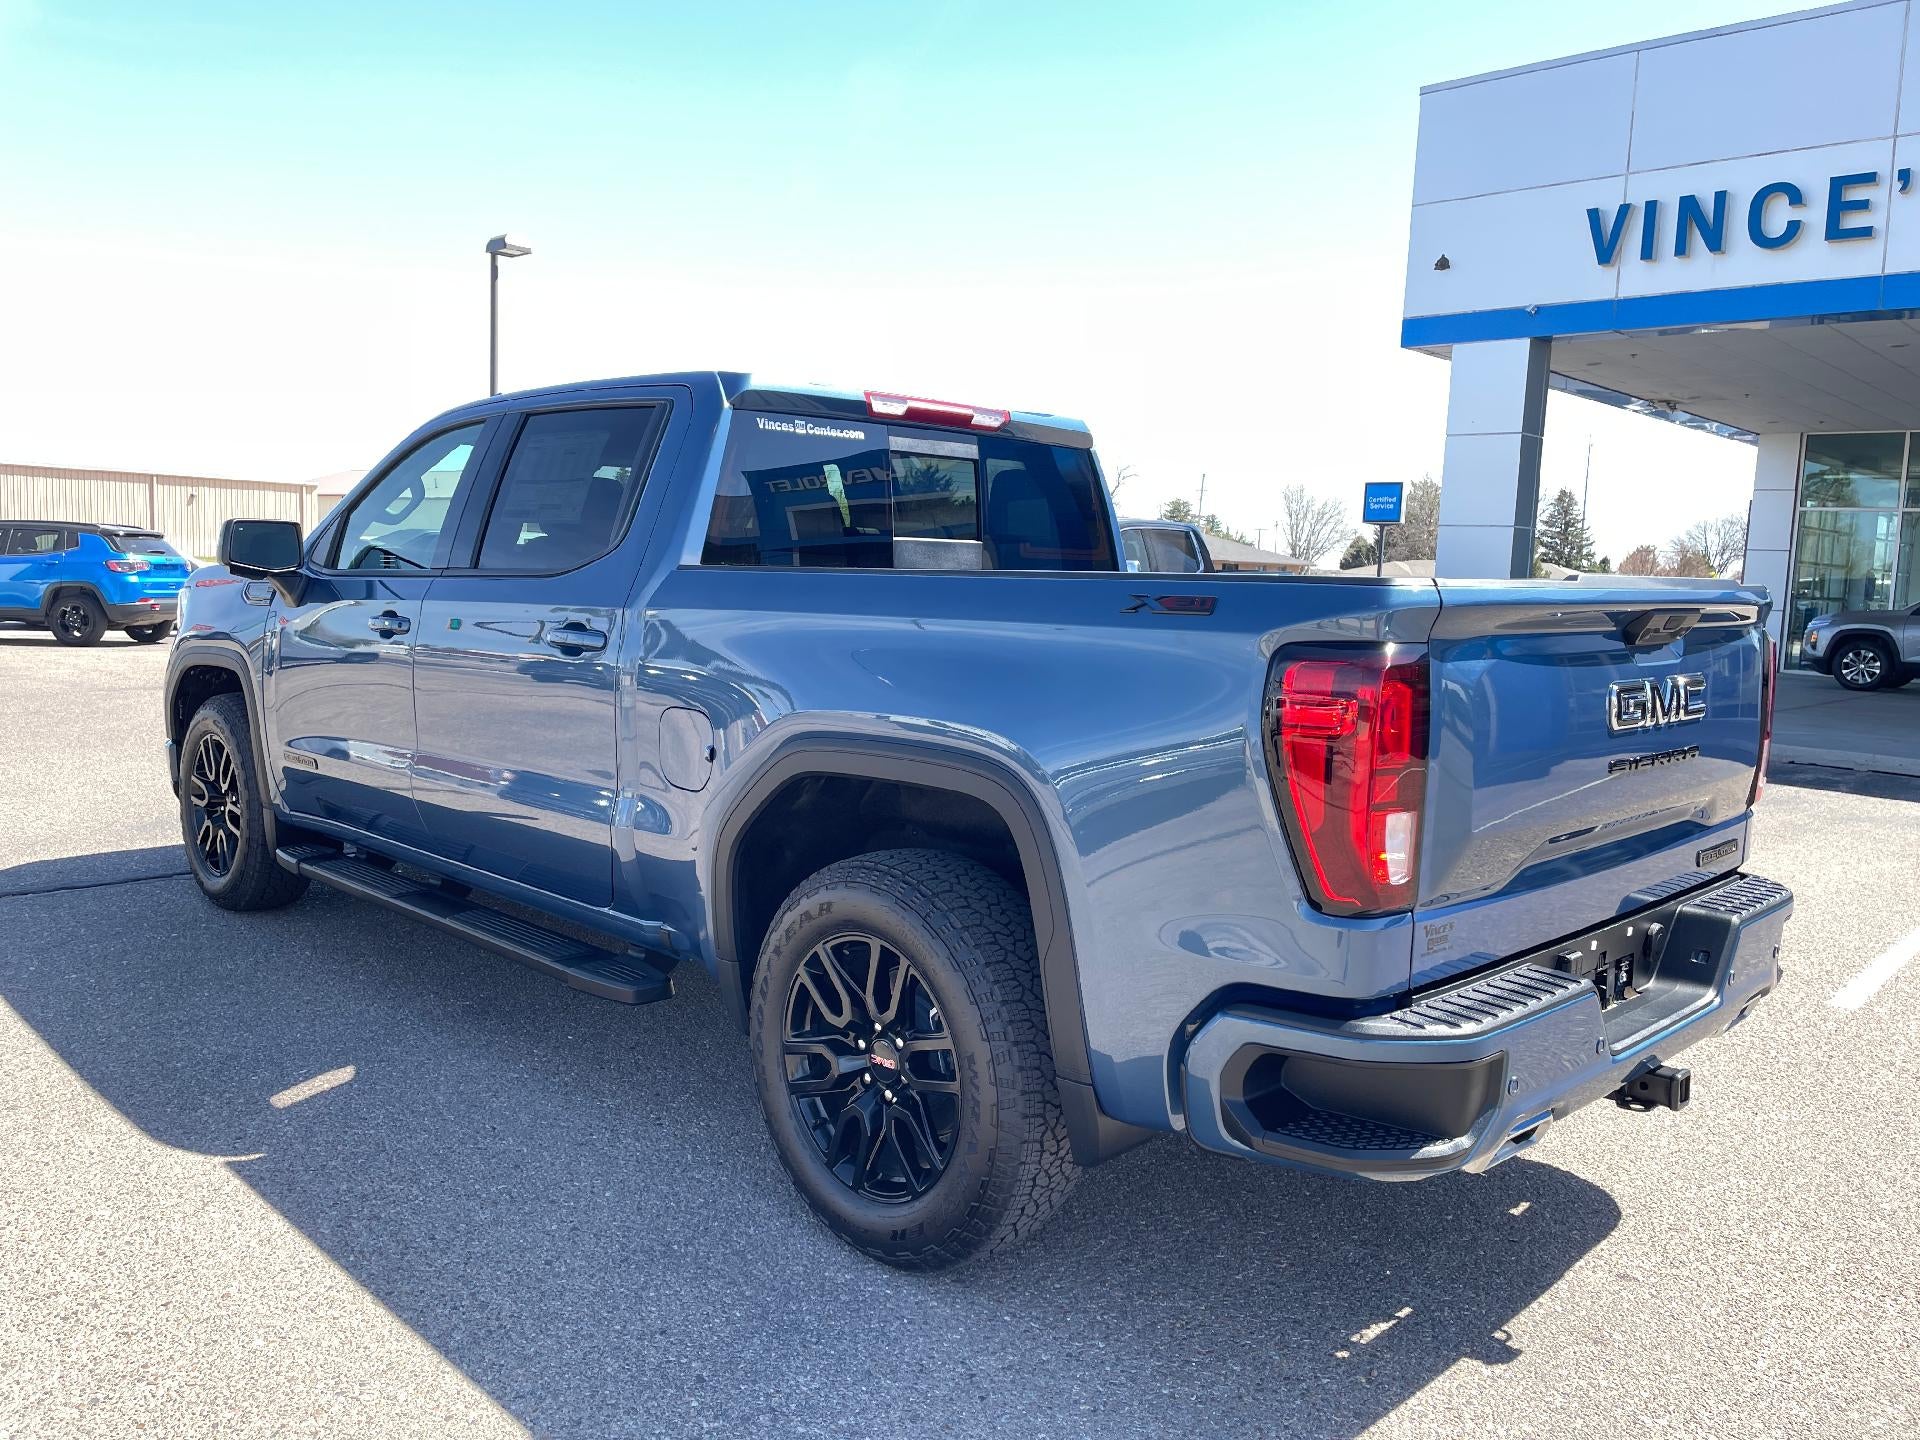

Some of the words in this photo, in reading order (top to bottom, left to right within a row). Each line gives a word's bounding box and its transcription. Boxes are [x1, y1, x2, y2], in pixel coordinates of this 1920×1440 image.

[1586, 167, 1913, 267] VINCE'
[1370, 502, 1394, 510] Service
[1606, 672, 1706, 732] GMC
[1608, 745, 1700, 774] SIERRA
